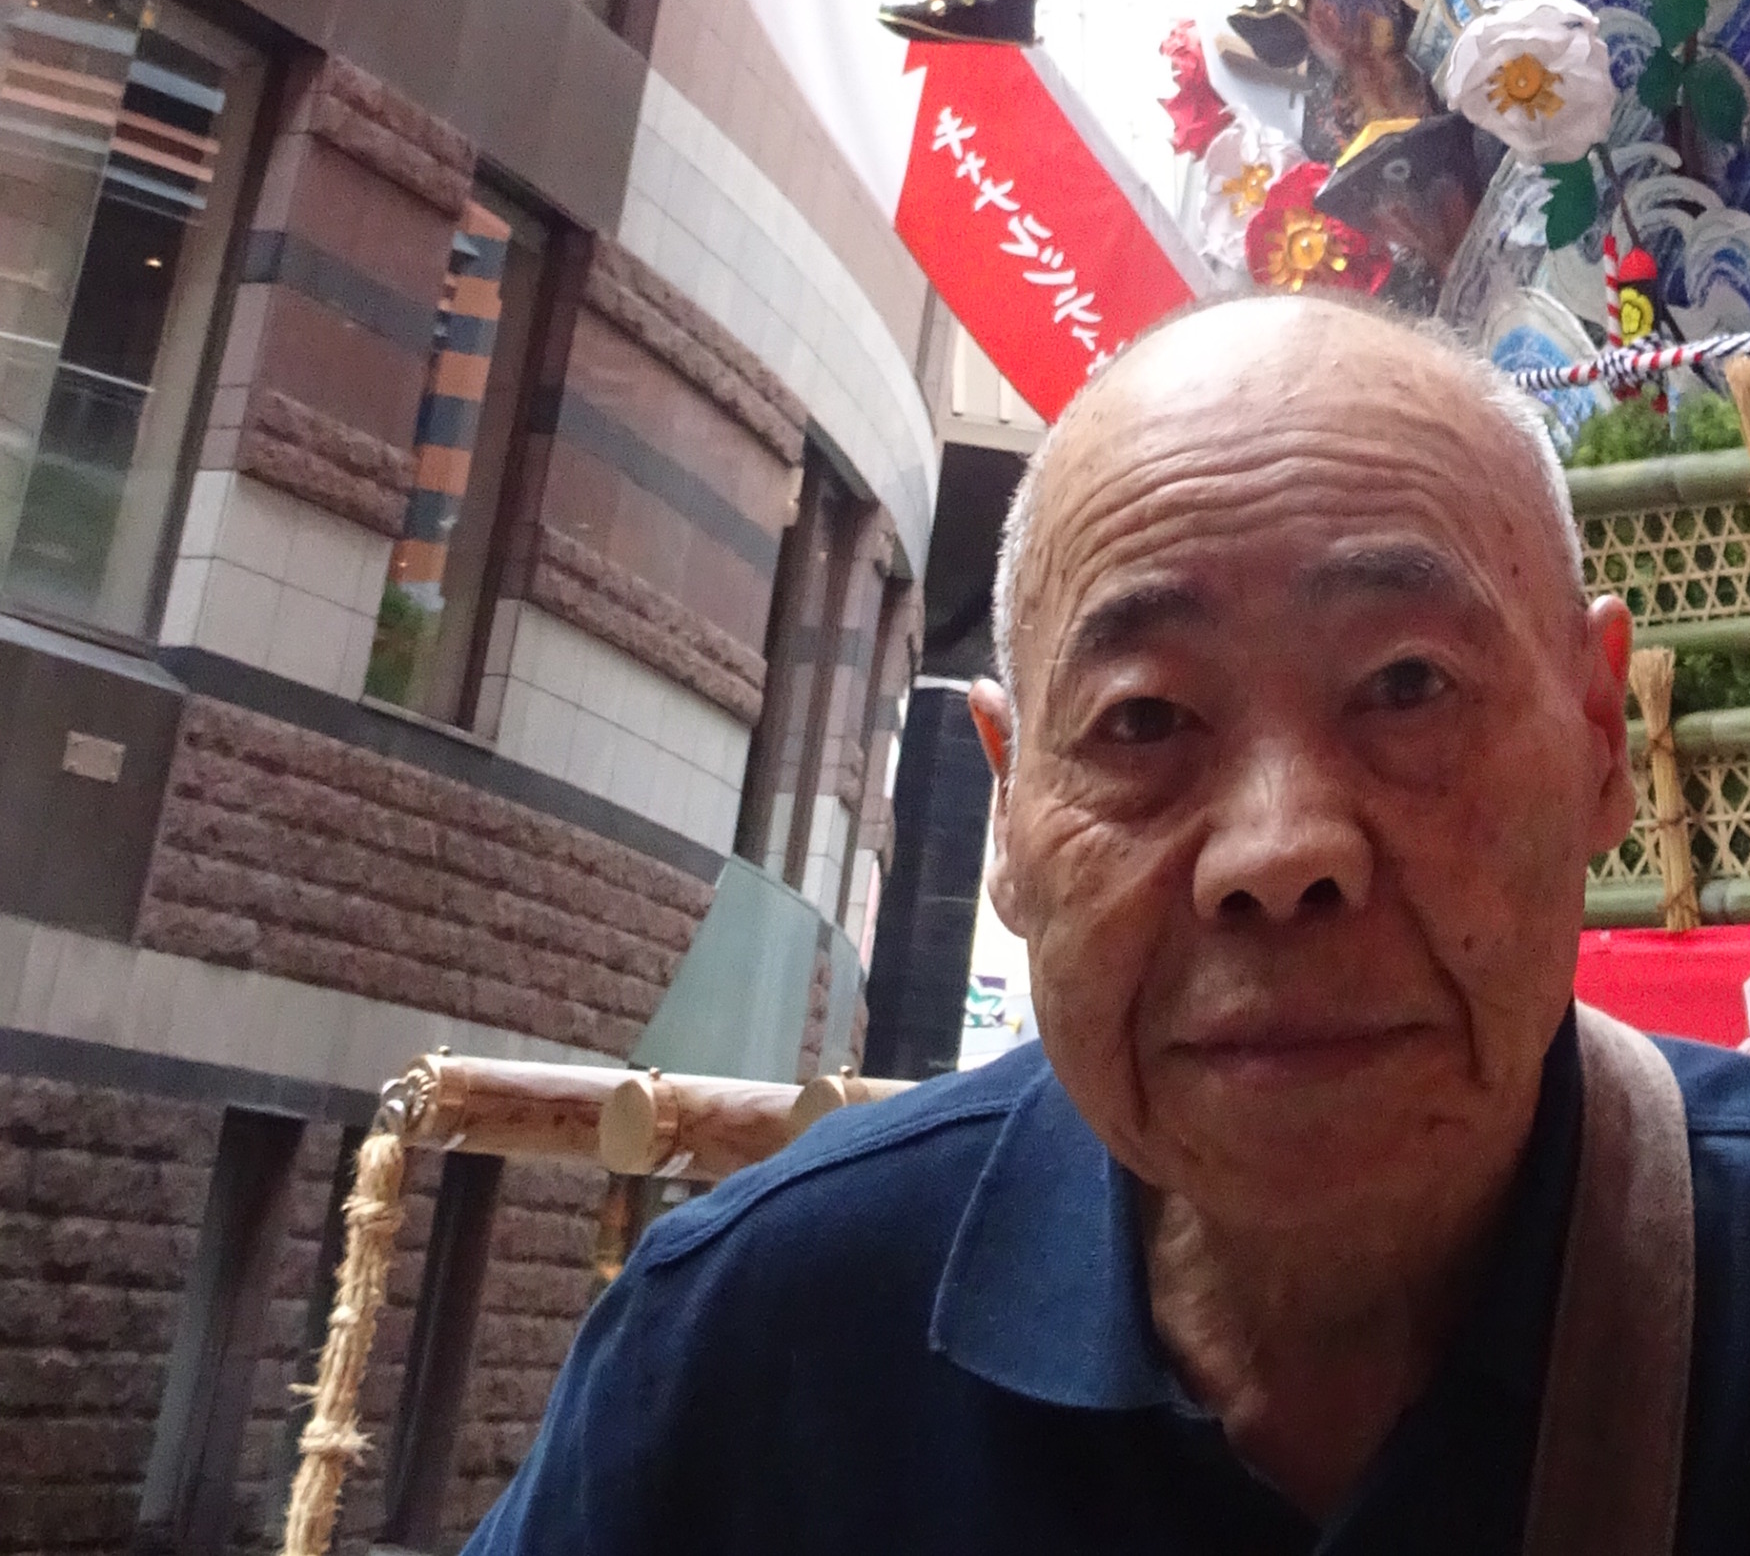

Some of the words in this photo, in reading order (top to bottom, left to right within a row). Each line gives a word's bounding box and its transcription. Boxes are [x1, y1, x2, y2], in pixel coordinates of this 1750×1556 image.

[931, 106, 1125, 375] キャナルシティ
